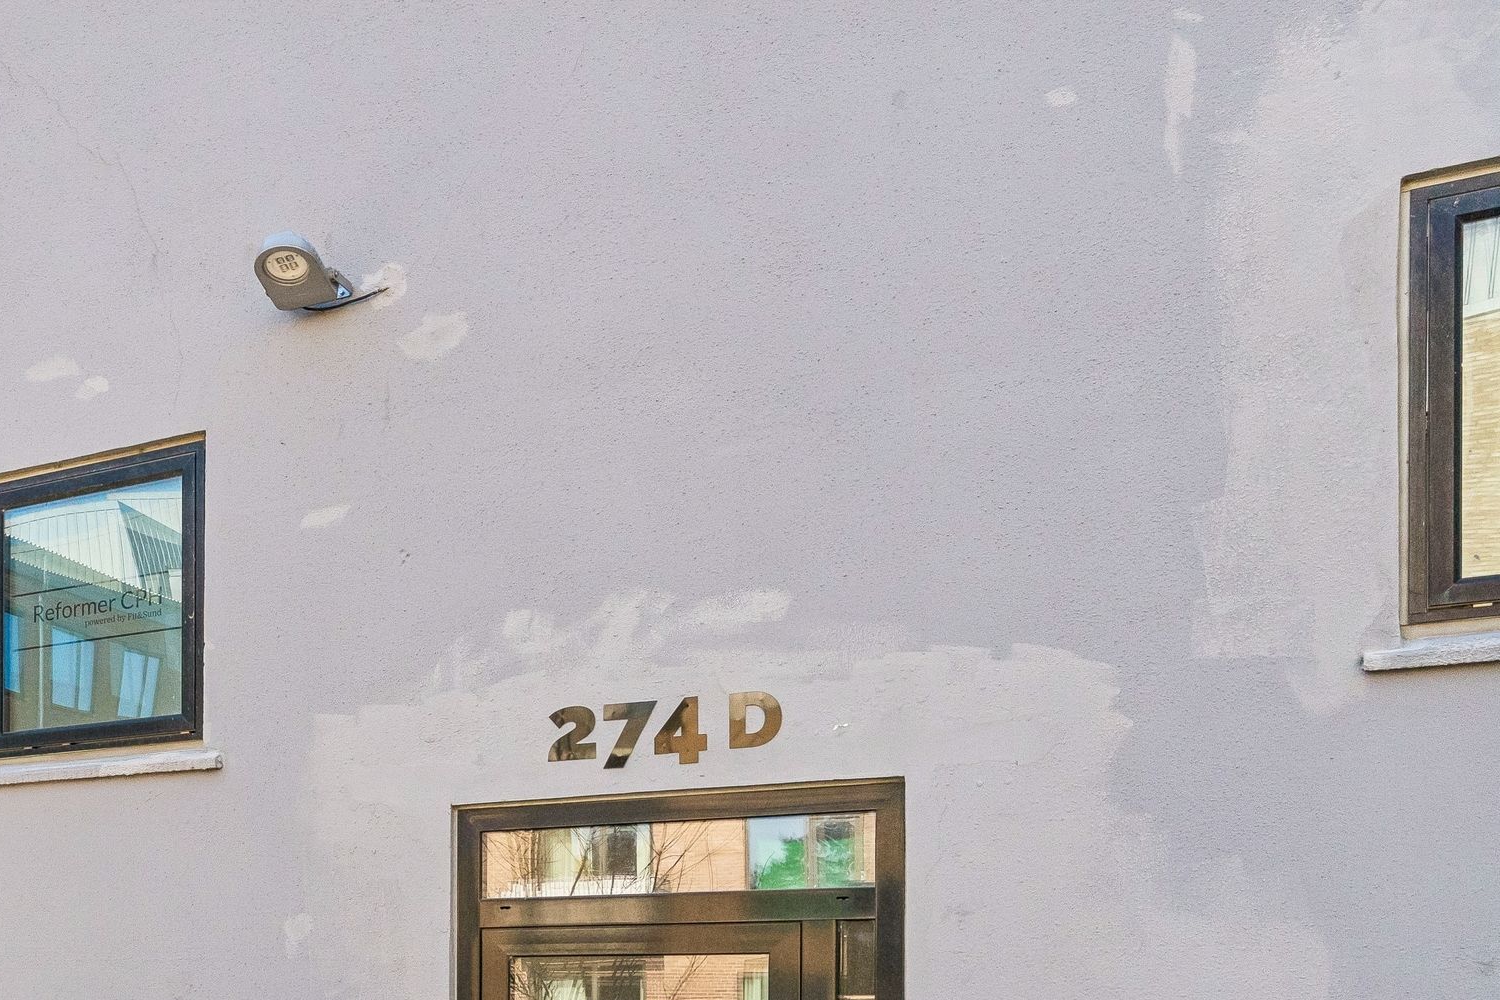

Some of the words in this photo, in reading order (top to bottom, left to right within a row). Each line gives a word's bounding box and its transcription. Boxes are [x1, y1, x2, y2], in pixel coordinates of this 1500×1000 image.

[33, 596, 116, 623] Reformer
[120, 585, 163, 610] CPH
[84, 616, 117, 629] powered
[117, 614, 127, 624] by
[548, 696, 708, 770] 274
[729, 691, 783, 749] D
